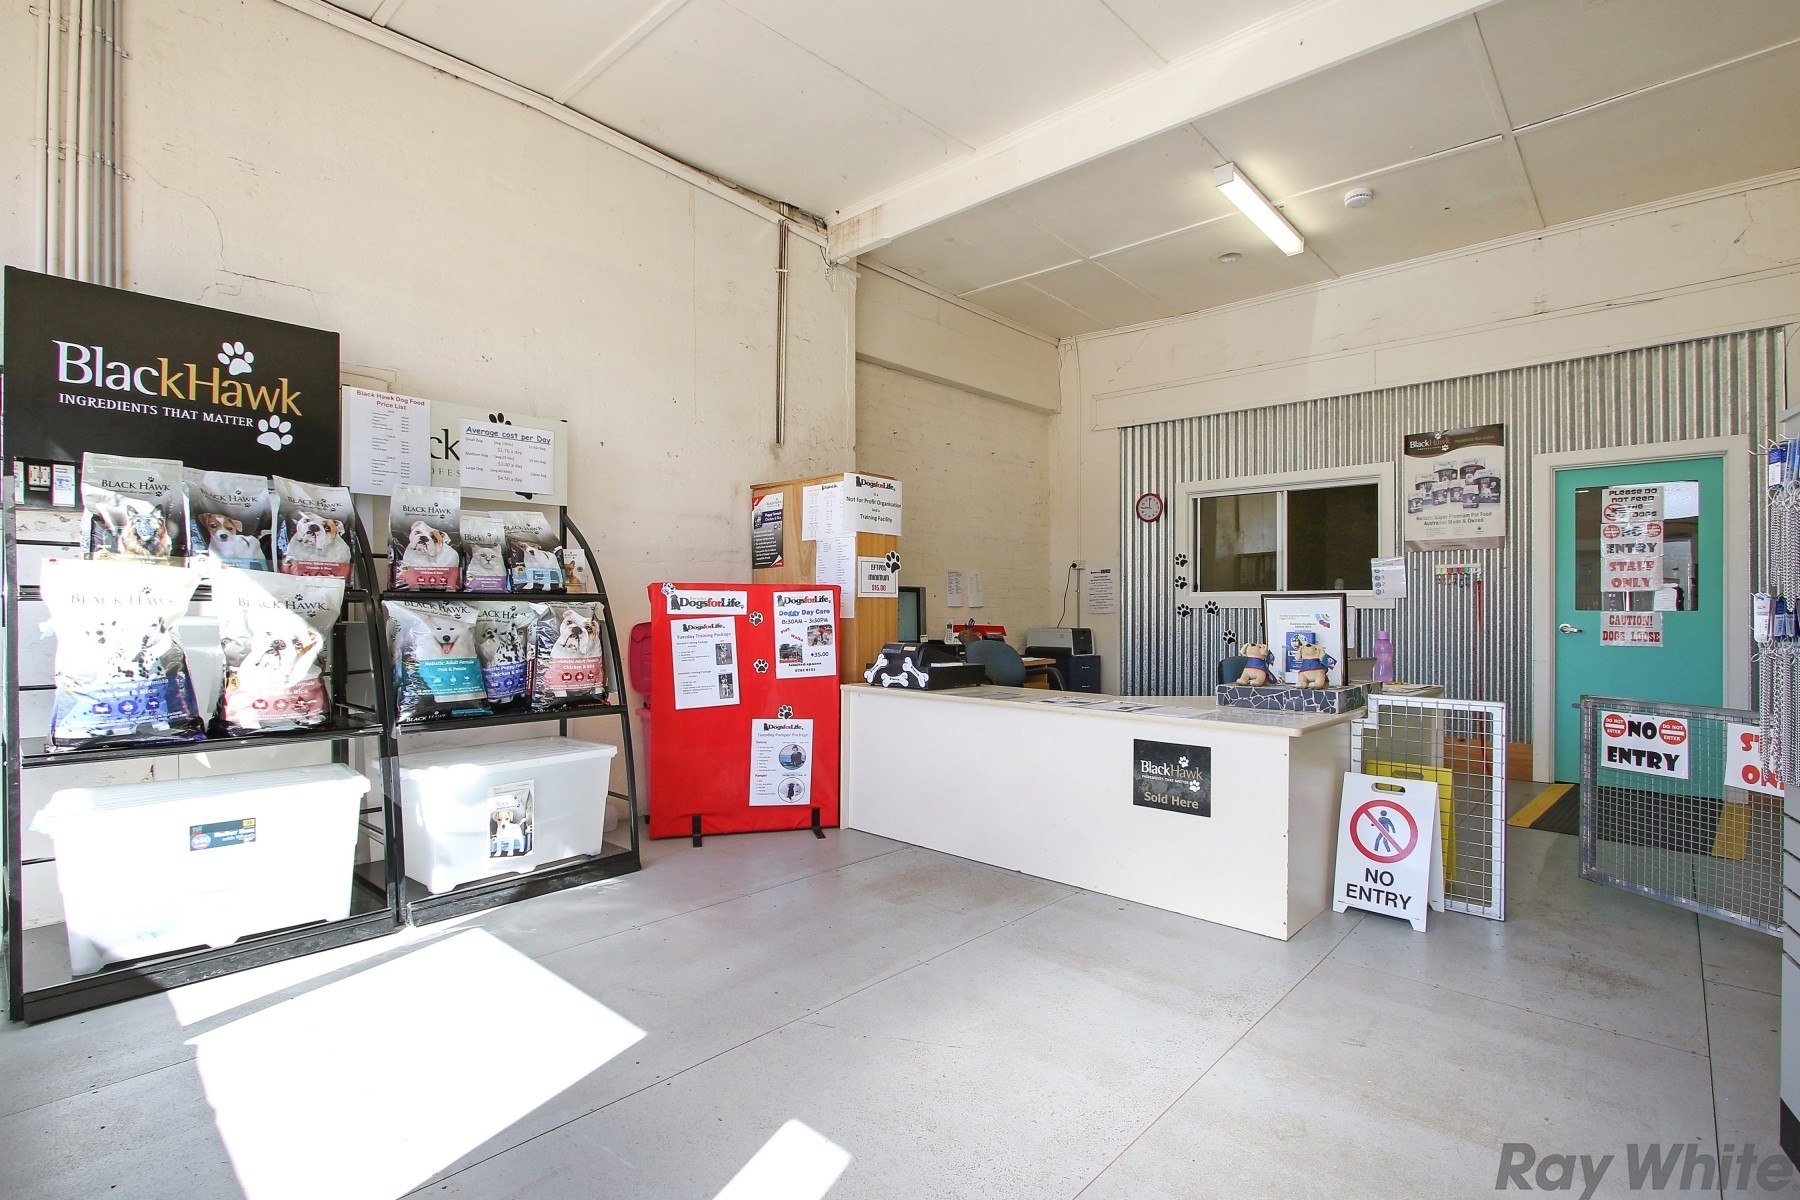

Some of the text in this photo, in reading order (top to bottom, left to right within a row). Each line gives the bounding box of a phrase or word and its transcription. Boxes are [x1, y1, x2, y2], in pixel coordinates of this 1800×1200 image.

[52, 339, 303, 416] BlackHawk
[356, 389, 425, 406] Black Hawk Dog Food
[58, 392, 254, 428] INGREDIENTS THAT MATTER
[376, 400, 407, 411] Price List
[466, 426, 551, 445] Average cost per Day
[101, 479, 170, 492] BLACK HAWK
[1608, 488, 1643, 496] PLEASE
[228, 494, 258, 503] HAWK
[287, 496, 343, 507] BLACK HAWK
[876, 500, 901, 508] Organisation
[402, 505, 452, 515] BLACK HAWK
[860, 514, 877, 522] Training
[1606, 542, 1658, 554] ENTRY
[1608, 560, 1655, 572] STAFF
[1611, 577, 1652, 588] ONLY
[680, 597, 741, 609] DogsforLife
[783, 595, 829, 606] DogsforLife
[478, 610, 500, 618] ACK
[1609, 614, 1653, 626] CAUTION!
[1602, 630, 1660, 643] DOGS LOOSE
[140, 678, 169, 688] Formula
[140, 687, 157, 695] Rice
[1627, 720, 1657, 740] NO
[1607, 745, 1680, 772] ENTRY
[1140, 759, 1204, 781] BlackHawk
[1144, 791, 1199, 809] Sold Here
[1364, 867, 1395, 887] NO
[1346, 882, 1412, 910] ENTRY
